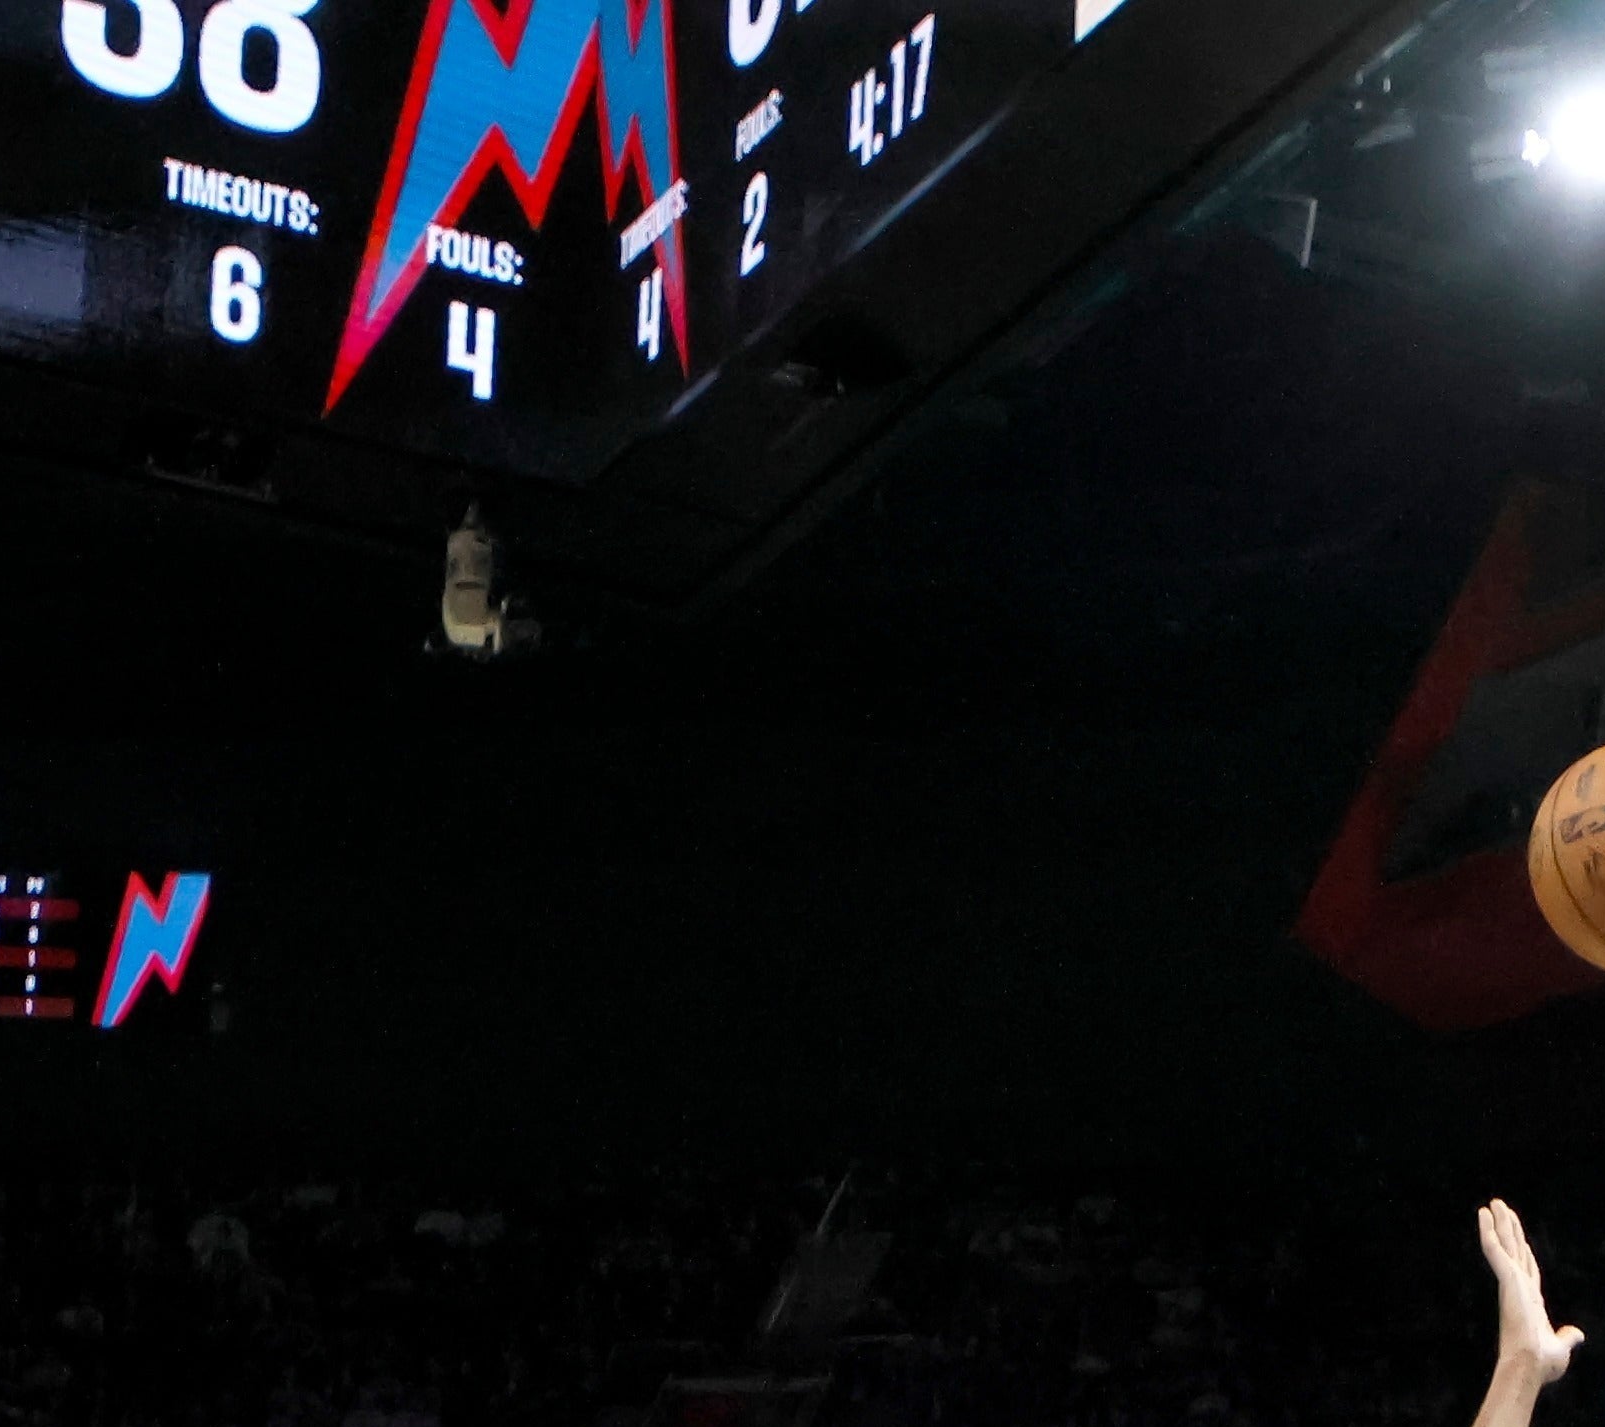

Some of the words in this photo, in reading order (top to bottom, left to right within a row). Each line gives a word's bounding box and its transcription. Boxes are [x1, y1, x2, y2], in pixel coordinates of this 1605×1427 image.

[848, 12, 935, 166] 4:17
[163, 158, 320, 235] TIMEOUTS:
[740, 171, 768, 277] 2
[209, 246, 262, 343] 6
[426, 225, 523, 285] FOULS:
[447, 301, 495, 400] 4
[637, 267, 663, 361] 4
